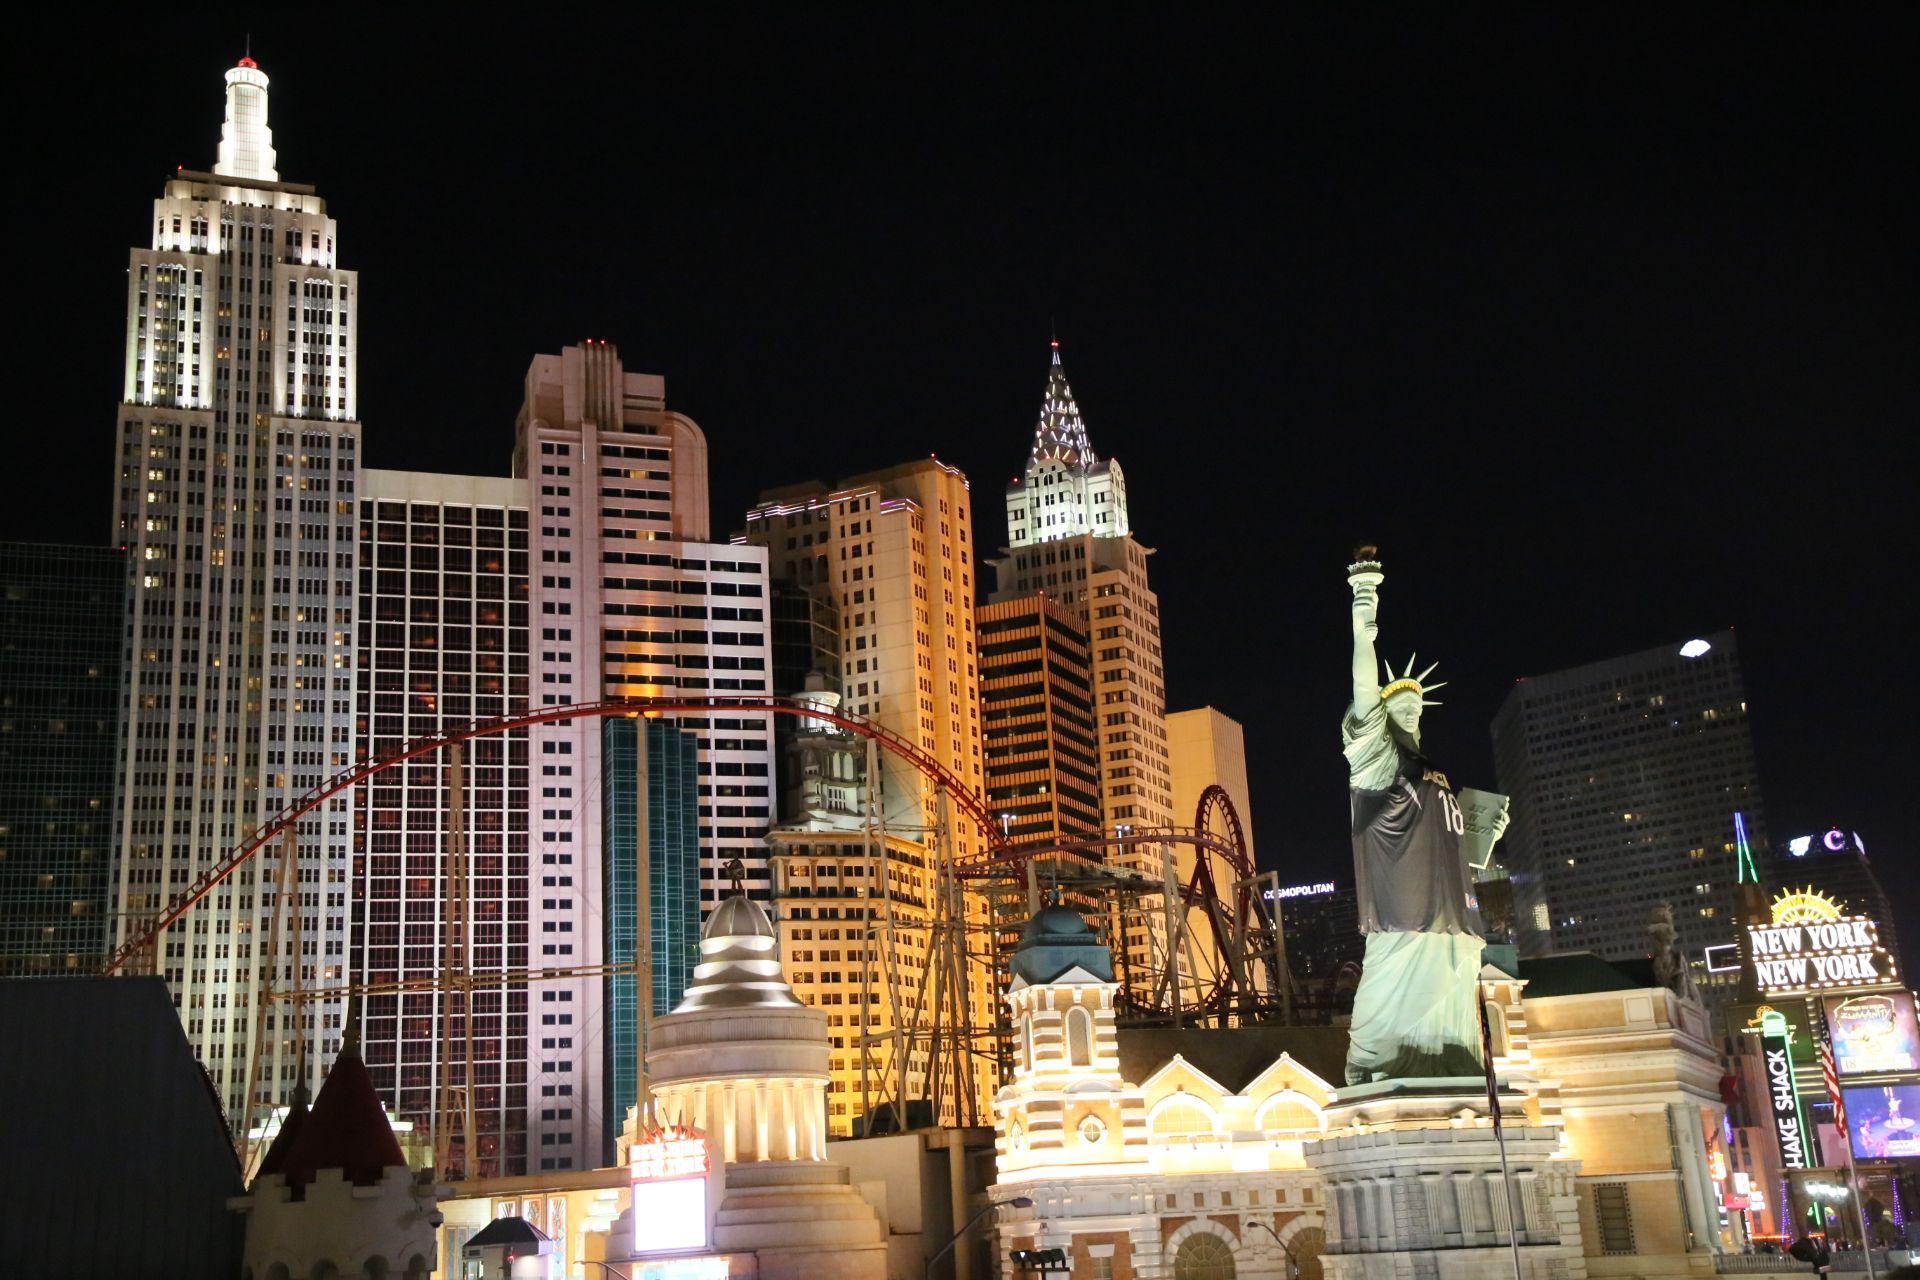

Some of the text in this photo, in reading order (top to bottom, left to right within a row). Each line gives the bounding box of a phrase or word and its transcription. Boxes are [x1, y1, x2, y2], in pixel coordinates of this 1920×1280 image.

[1438, 790, 1464, 835] 18
[1824, 830, 1844, 850] C
[1264, 883, 1335, 899] COSMOPOLITAN
[1750, 921, 1873, 955] NEW YORK
[1754, 952, 1878, 986] NEW YORK
[1766, 1049, 1804, 1168] HAKE SHACK
